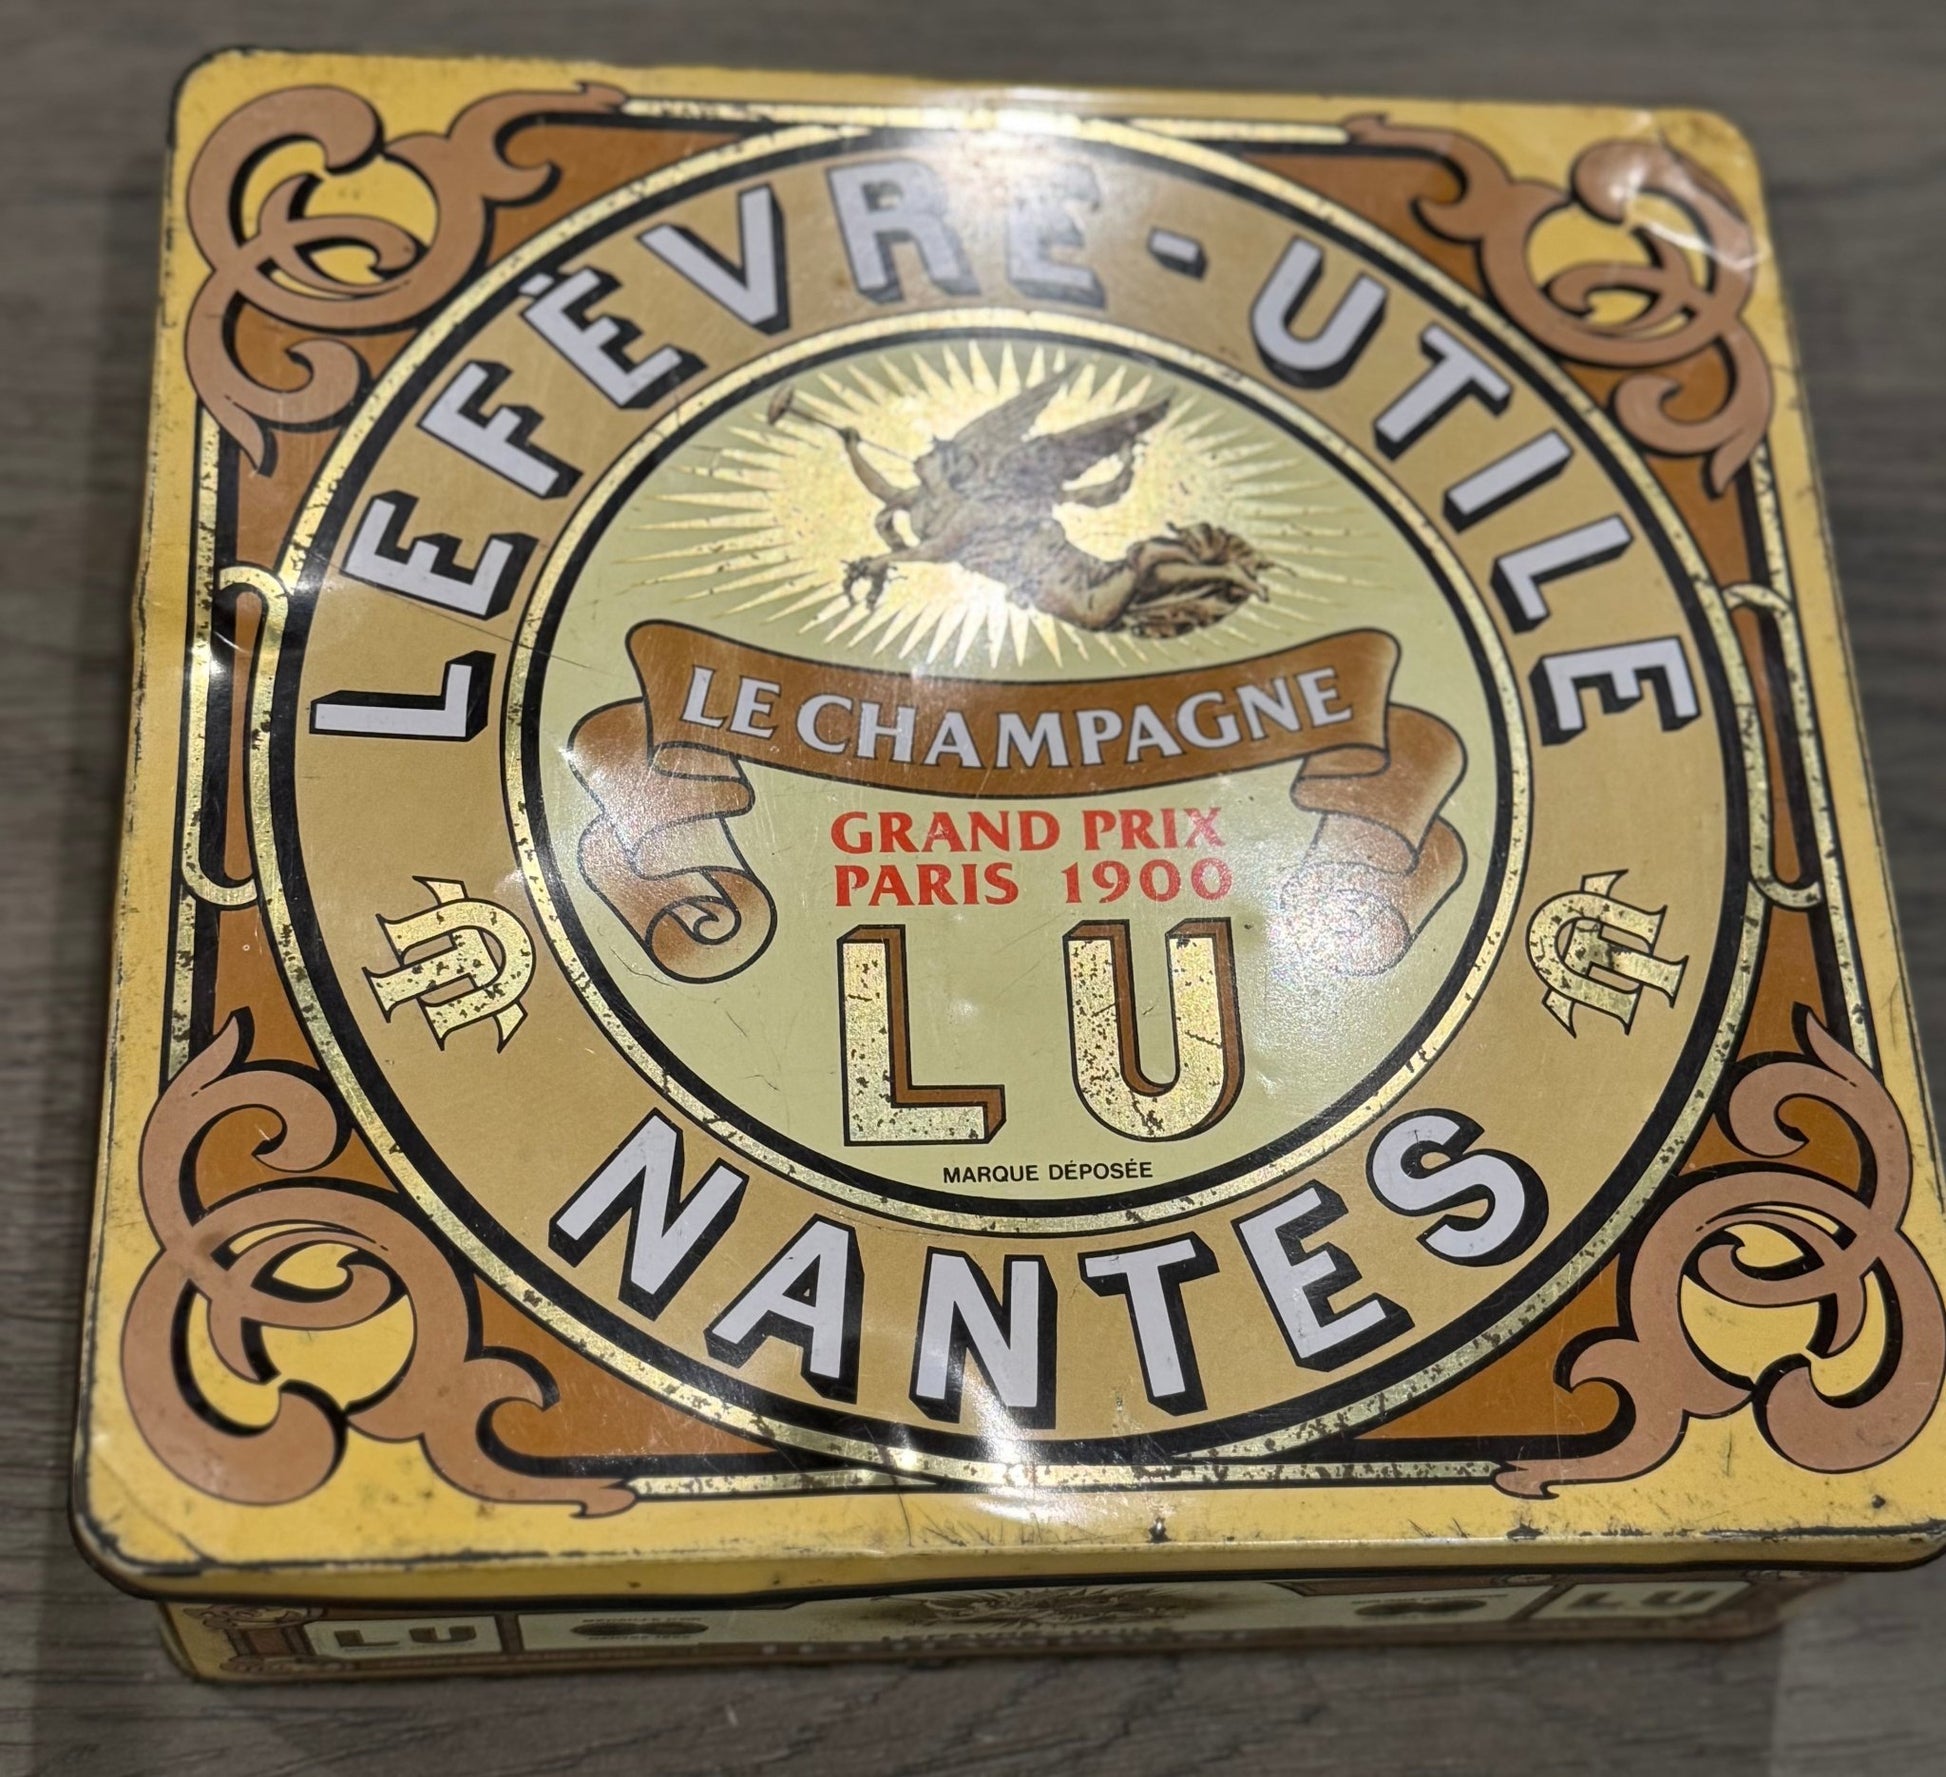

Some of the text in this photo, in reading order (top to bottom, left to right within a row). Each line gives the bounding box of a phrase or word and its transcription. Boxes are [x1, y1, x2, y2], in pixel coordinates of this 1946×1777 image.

[679, 664, 1353, 770] LE CHAMPAGNE
[829, 807, 1227, 856] GRAND PRIX
[834, 857, 1233, 908] PARIS 1900
[836, 916, 1246, 1147] LU
[943, 1158, 1154, 1183] MARQUE DÉPOSÉE
[548, 1106, 1549, 1429] NANTES
[334, 1624, 477, 1649] LU
